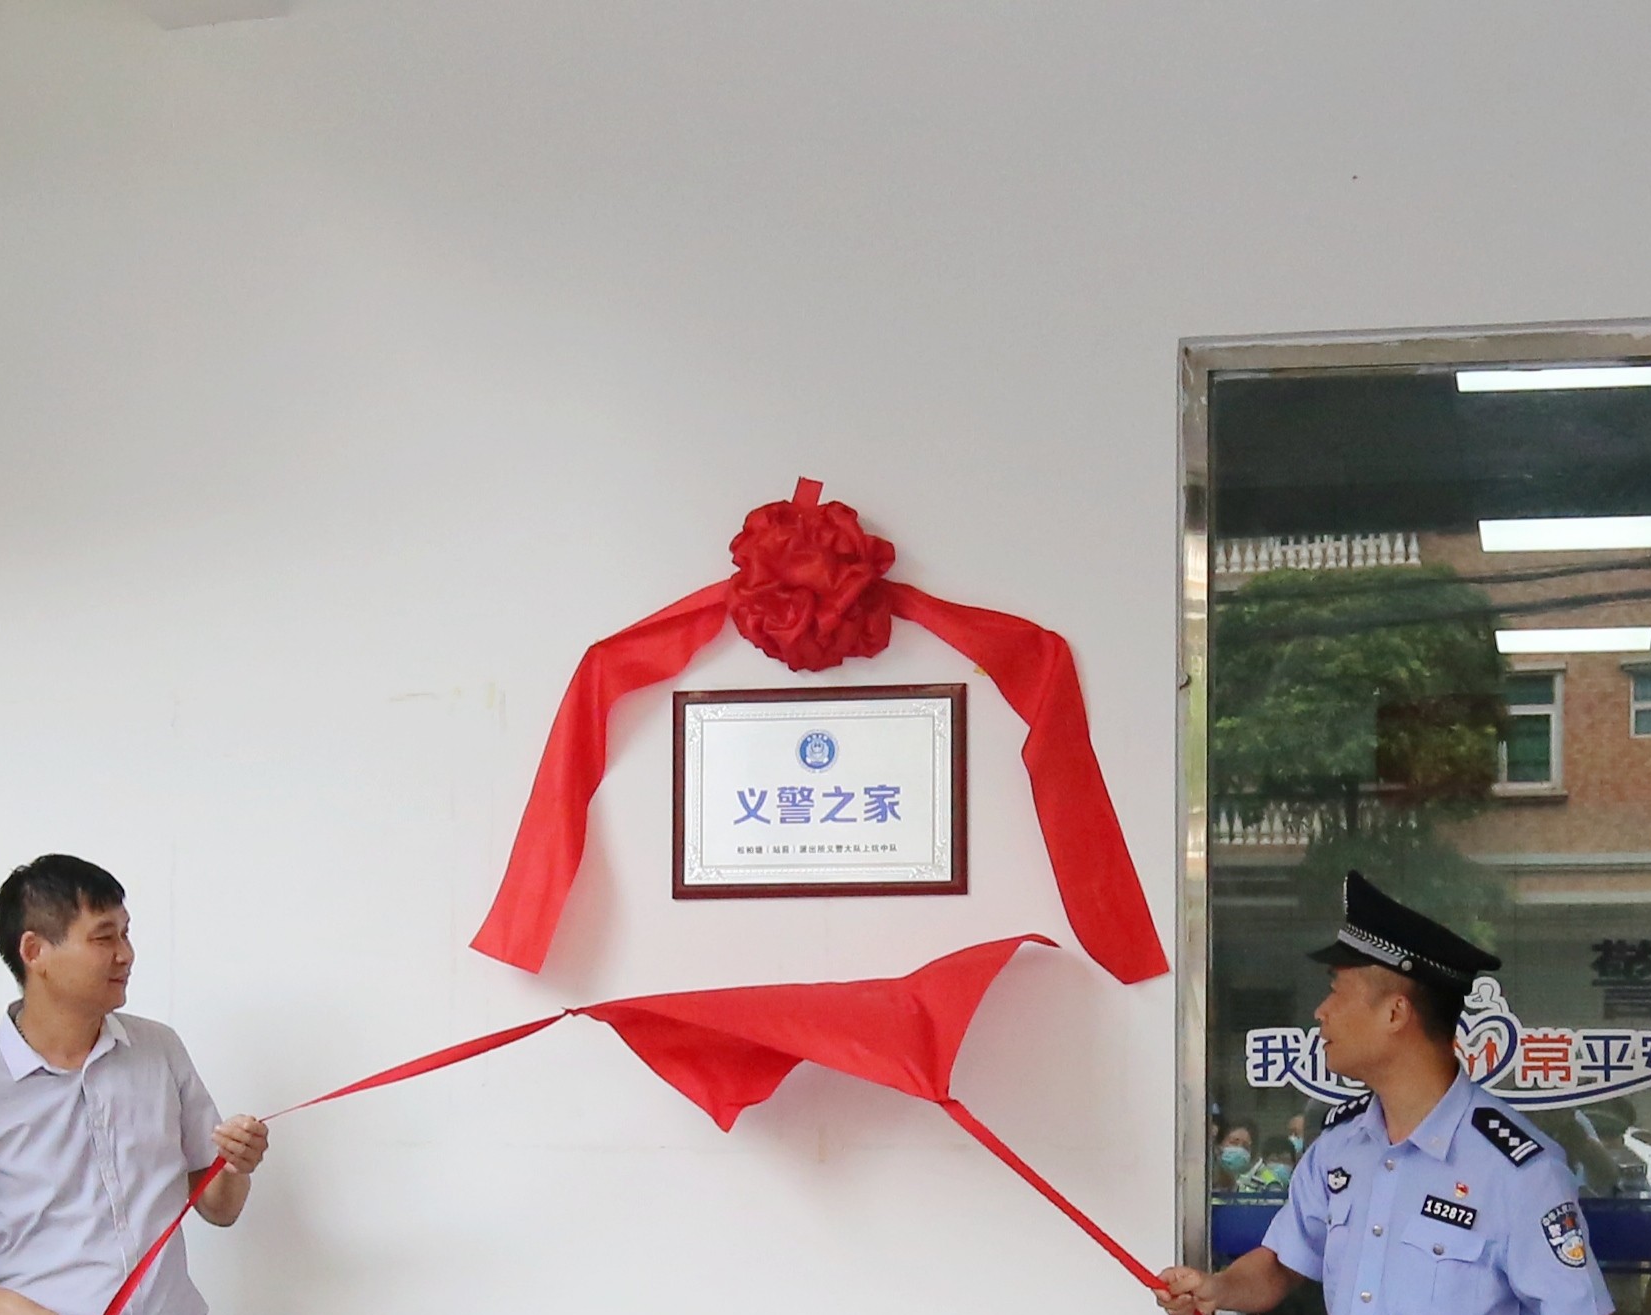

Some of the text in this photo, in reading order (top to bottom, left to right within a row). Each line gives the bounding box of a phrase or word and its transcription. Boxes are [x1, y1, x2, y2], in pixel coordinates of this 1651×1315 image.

[733, 784, 901, 825] 义警之家
[1424, 1199, 1474, 1226] 152872
